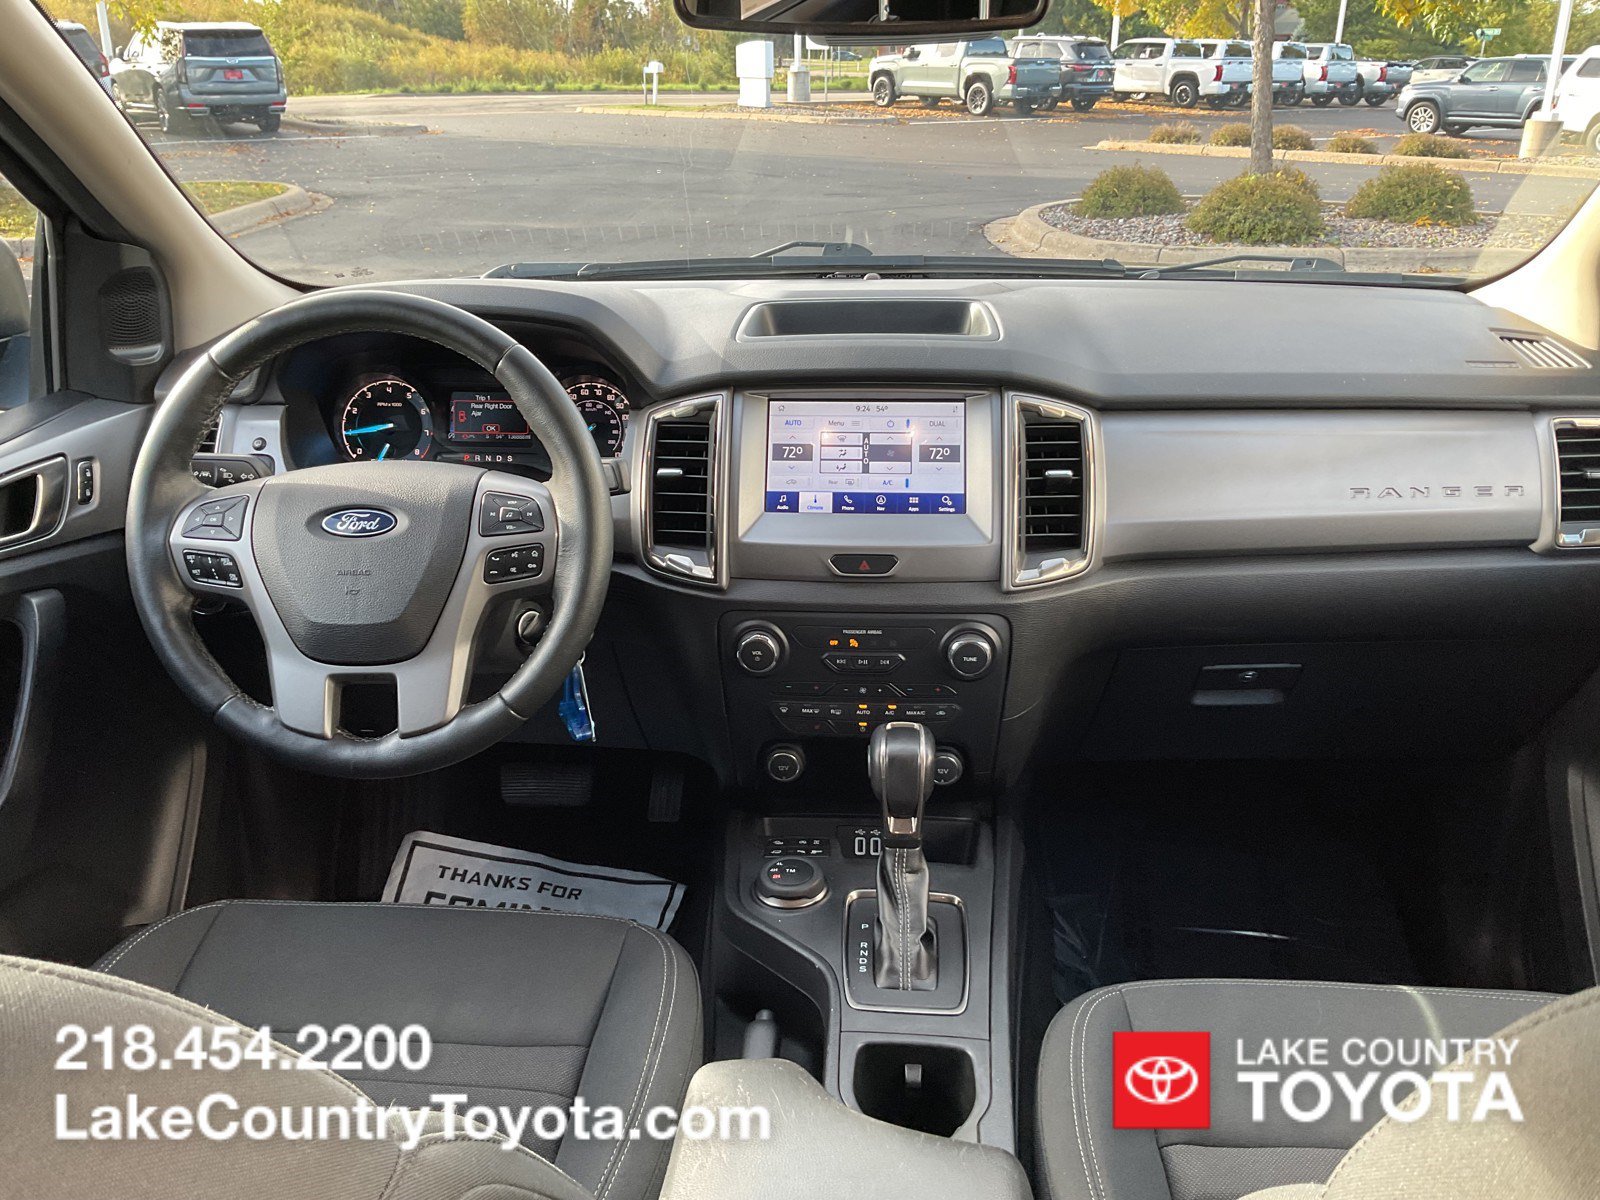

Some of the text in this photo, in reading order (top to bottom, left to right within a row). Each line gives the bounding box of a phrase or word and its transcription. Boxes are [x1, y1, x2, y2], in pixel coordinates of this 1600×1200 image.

[1349, 485, 1525, 498] RANGER
[336, 512, 380, 530] Ford
[437, 865, 582, 900] THANKS FOR
